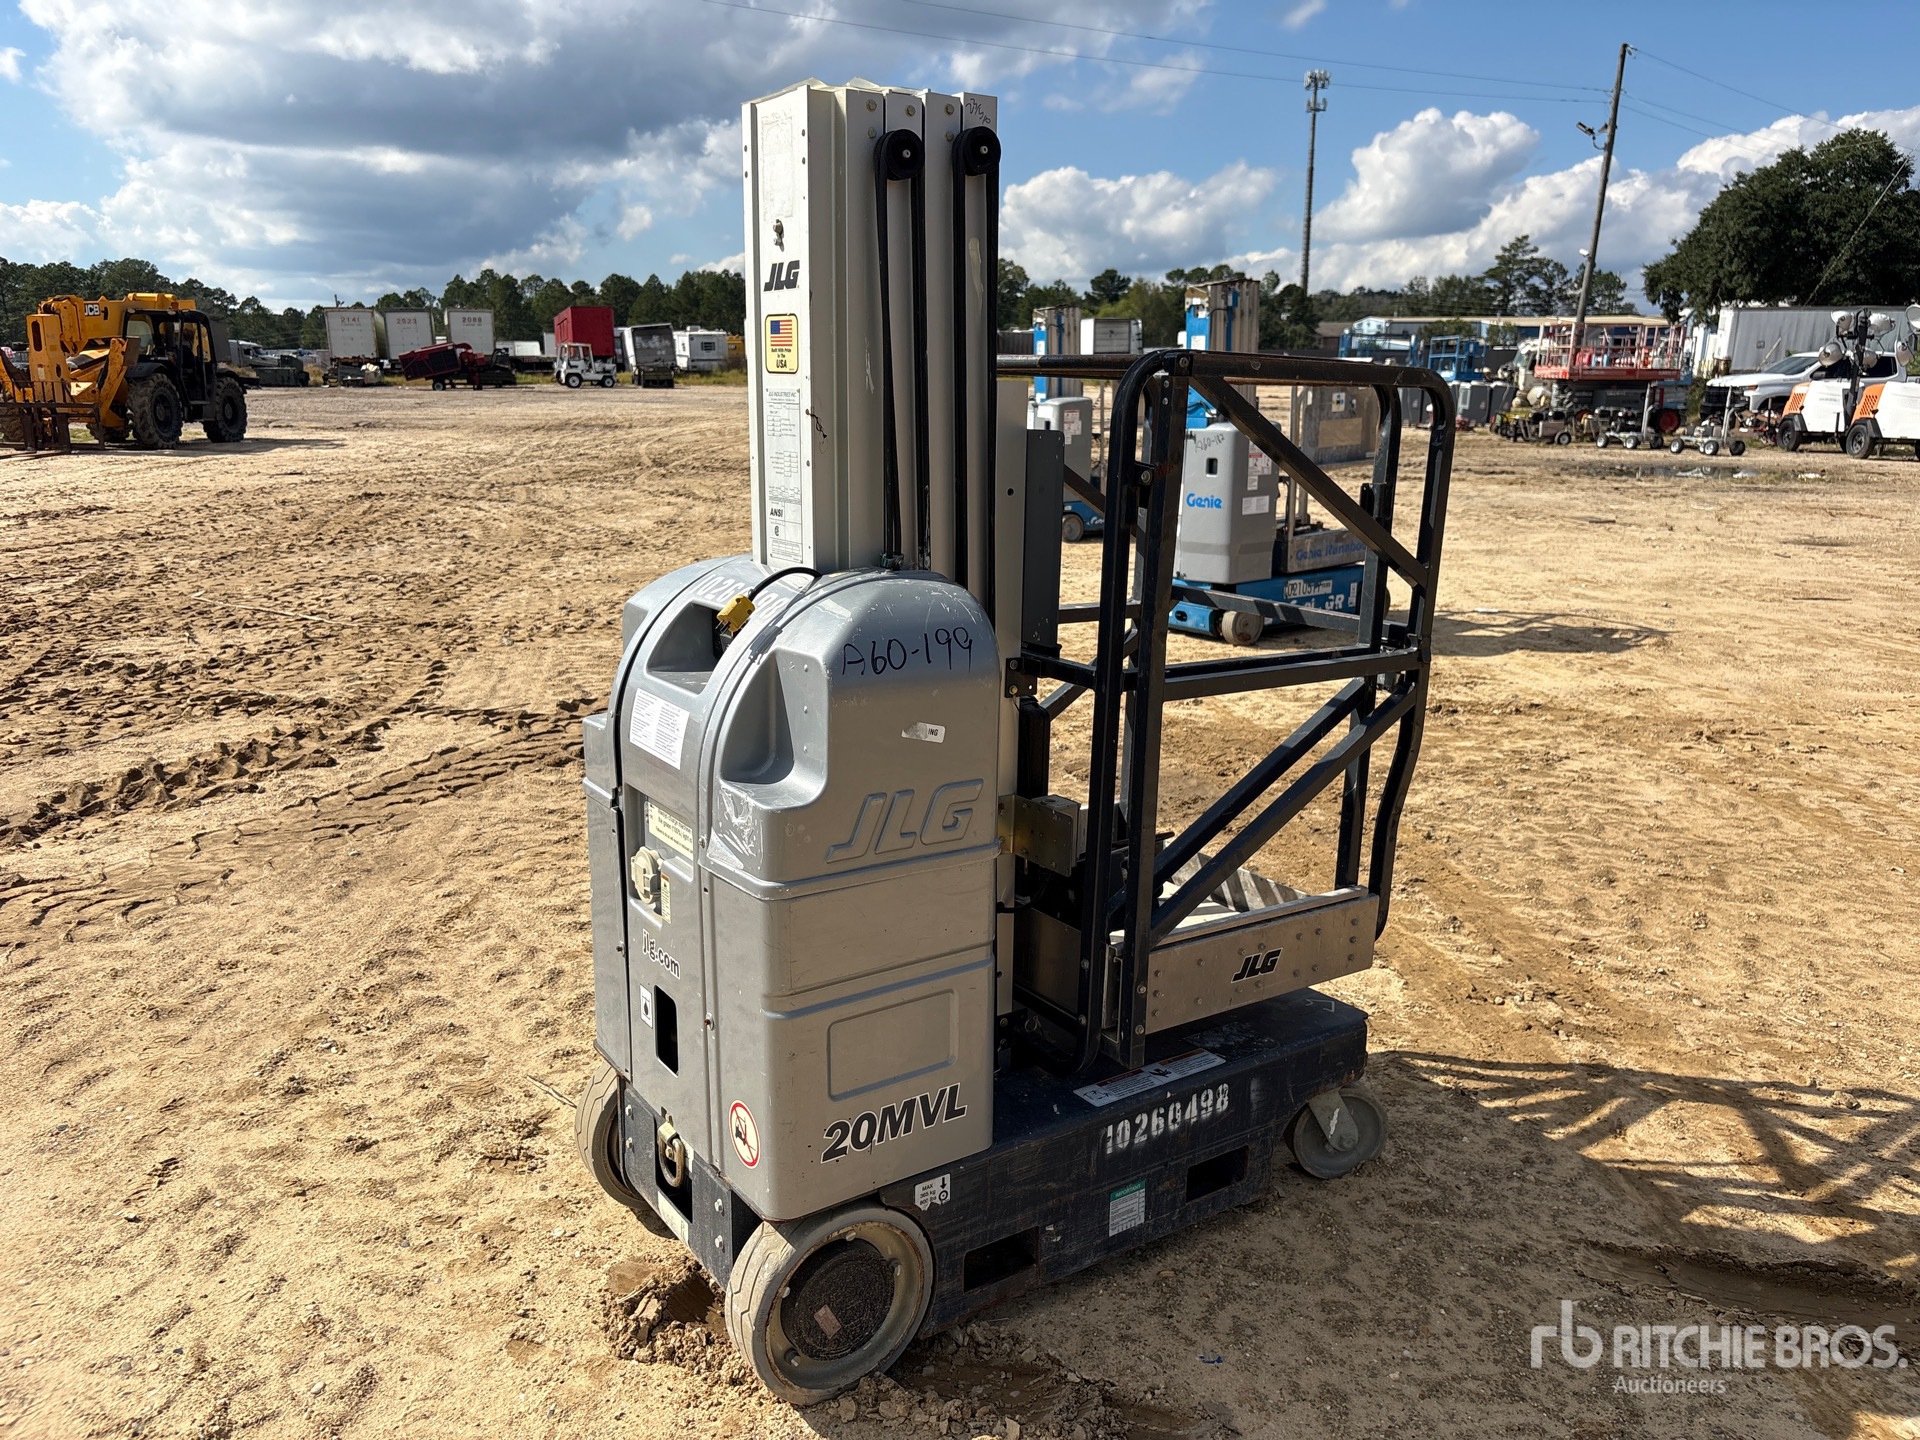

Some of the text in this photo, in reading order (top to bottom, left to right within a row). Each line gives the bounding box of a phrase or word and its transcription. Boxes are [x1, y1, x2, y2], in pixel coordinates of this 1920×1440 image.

[763, 260, 800, 291] JLG
[85, 304, 100, 316] JCB
[776, 359, 787, 368] USA
[770, 508, 783, 517] ANSI
[1186, 493, 1222, 509] Genie
[842, 627, 973, 674] A60-199
[825, 778, 984, 864] JLG
[642, 928, 681, 980] jlg.com
[1230, 947, 1283, 983] JLG
[820, 1082, 968, 1164] 20MVL
[1106, 1083, 1229, 1155] 10260498
